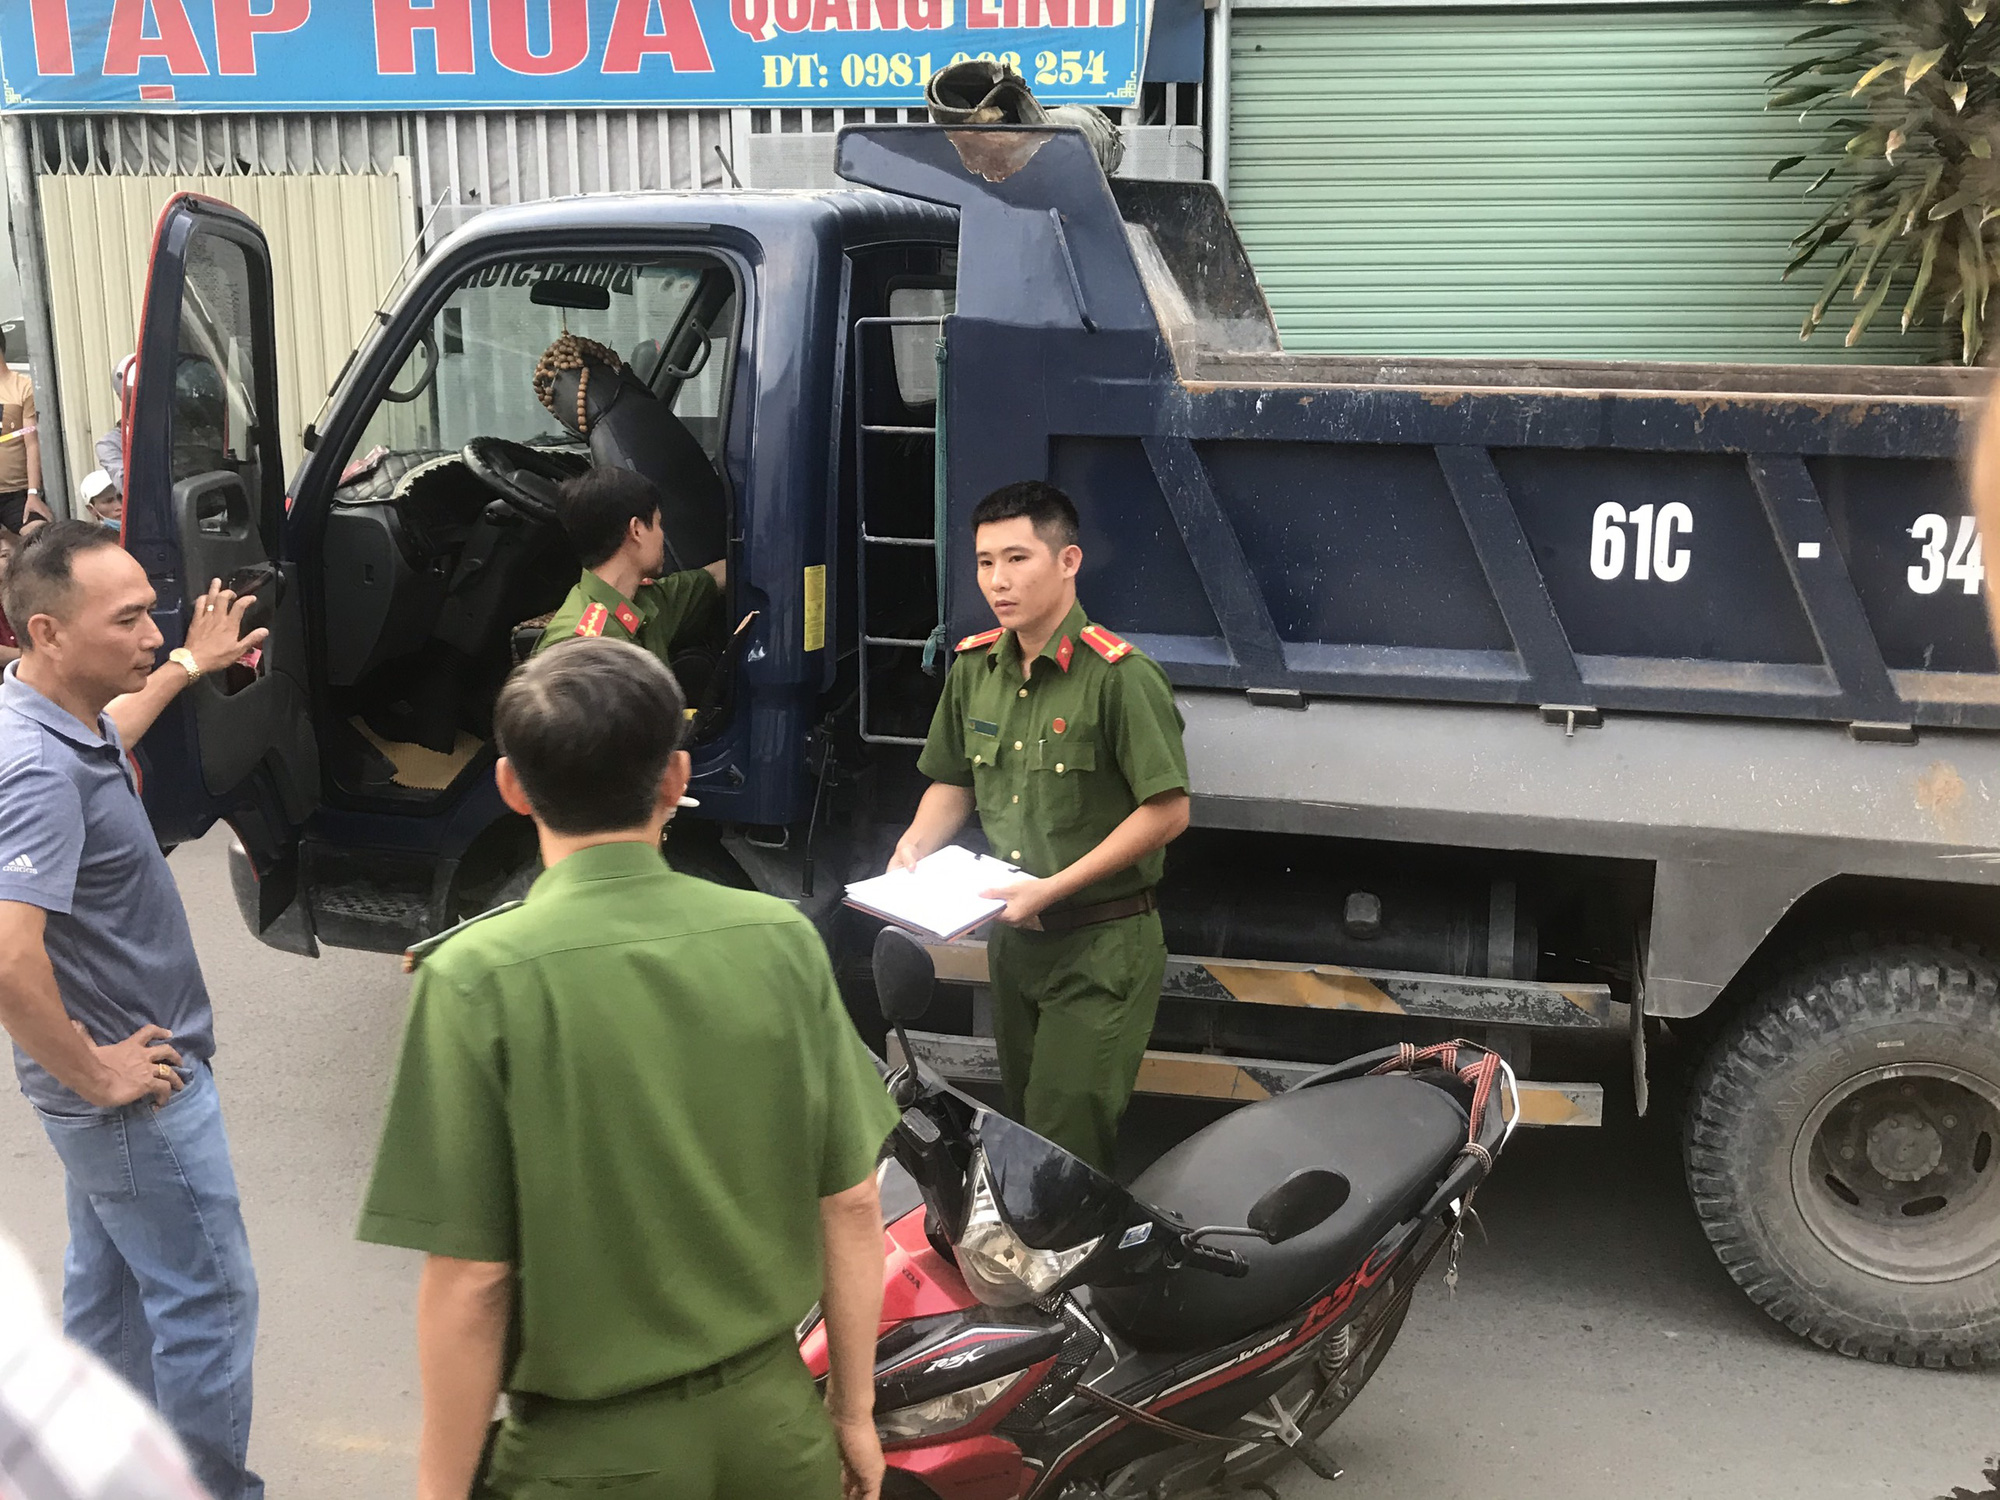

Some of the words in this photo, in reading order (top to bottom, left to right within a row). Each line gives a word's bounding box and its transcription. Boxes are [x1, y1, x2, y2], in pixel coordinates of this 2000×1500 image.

[761, 52, 829, 88] ĐT:
[841, 51, 932, 88] 0981
[1035, 49, 1109, 85] 254
[1589, 501, 1694, 582] 61C
[2, 865, 38, 874] adidas
[922, 1345, 986, 1374] RSX
